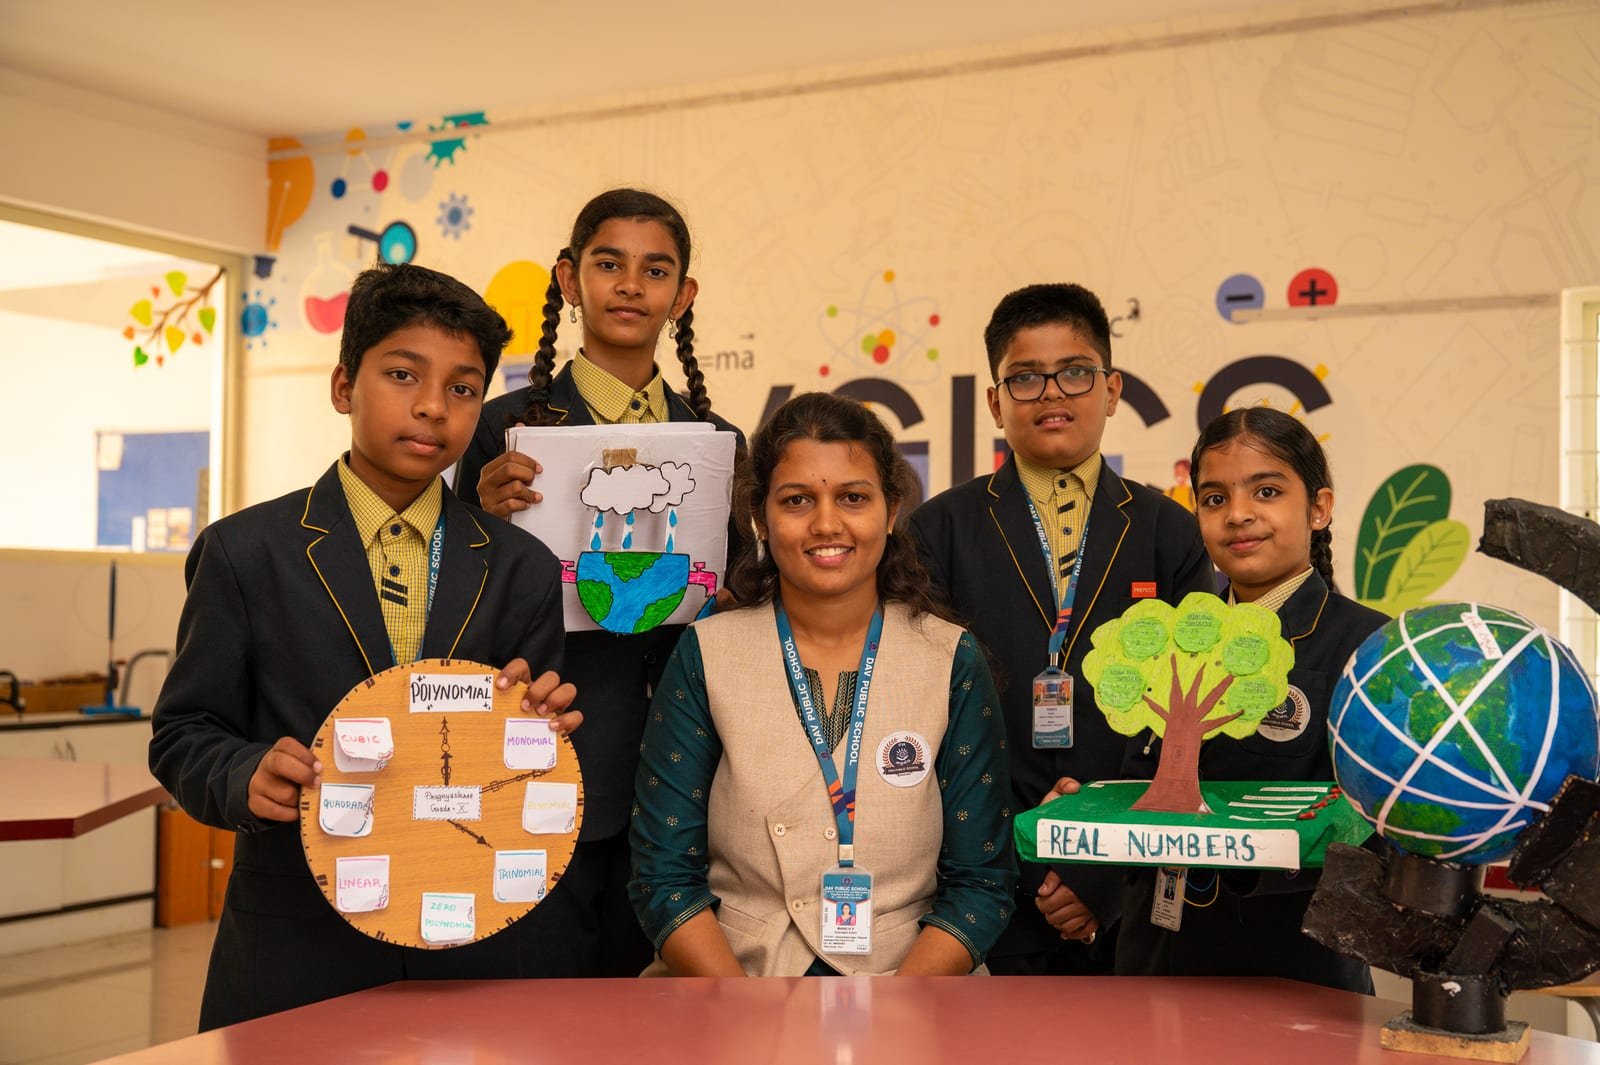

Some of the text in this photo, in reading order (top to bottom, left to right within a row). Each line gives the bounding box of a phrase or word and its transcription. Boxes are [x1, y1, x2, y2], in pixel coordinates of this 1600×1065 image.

[1034, 521, 1050, 551] PUBLIC
[432, 526, 442, 569] SCHOOL
[784, 636, 824, 745] DAV PUBLIC SCHOOL
[849, 657, 875, 766] DAV PUBLIC SCHOOL
[341, 734, 381, 743] CUBIC
[507, 735, 554, 746] MONOMIAL
[1050, 824, 1256, 862] REAL NUMBERS
[338, 877, 381, 890] LINEAR
[497, 867, 545, 880] TRINOMIAL
[431, 902, 457, 911] ZERO
